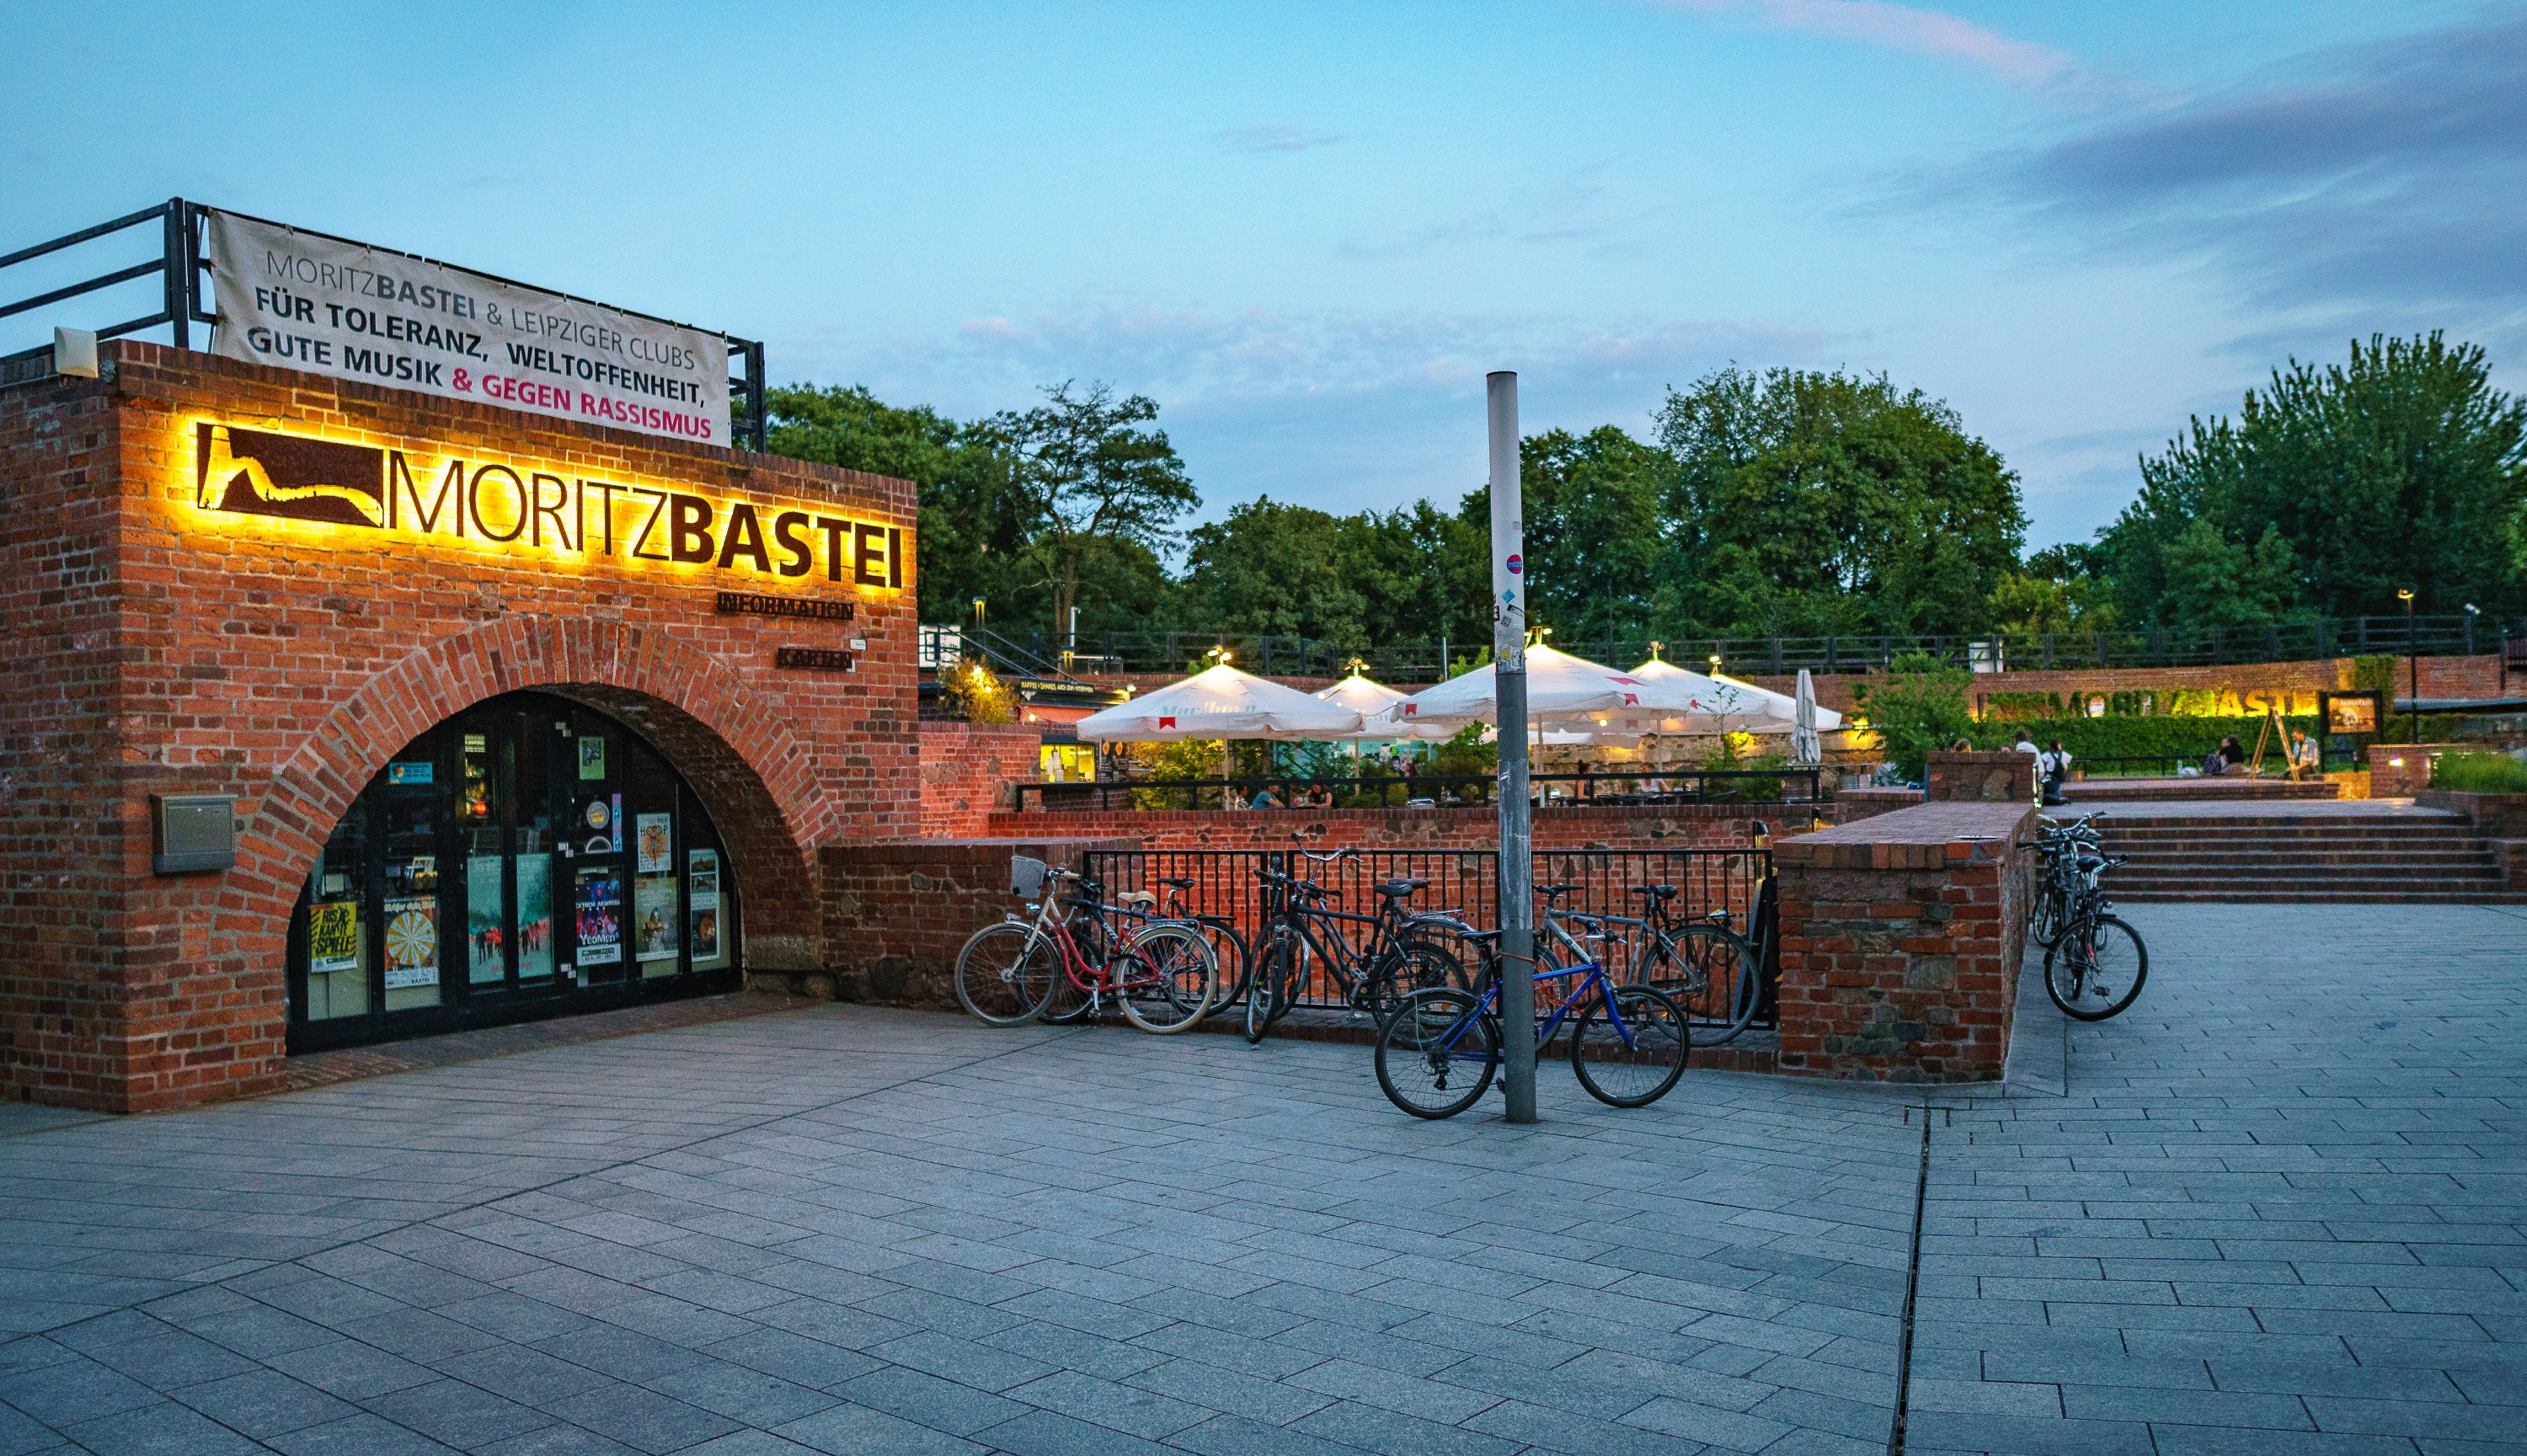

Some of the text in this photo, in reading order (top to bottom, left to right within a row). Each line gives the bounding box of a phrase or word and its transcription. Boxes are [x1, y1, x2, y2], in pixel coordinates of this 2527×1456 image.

[254, 285, 705, 408] FÜR TOLERANZ, WELTOFFENHEIT,
[266, 250, 696, 371] MORITZBASTEI & LEIPZIGER CLUBS
[247, 326, 712, 439] GUTE MUSIK & GEGEN RASSISMUS
[389, 451, 901, 588] MORITZBASTEI
[718, 592, 854, 621] INFORMATION
[777, 648, 852, 669] KARTEN
[1021, 680, 1038, 690] KAFFEE
